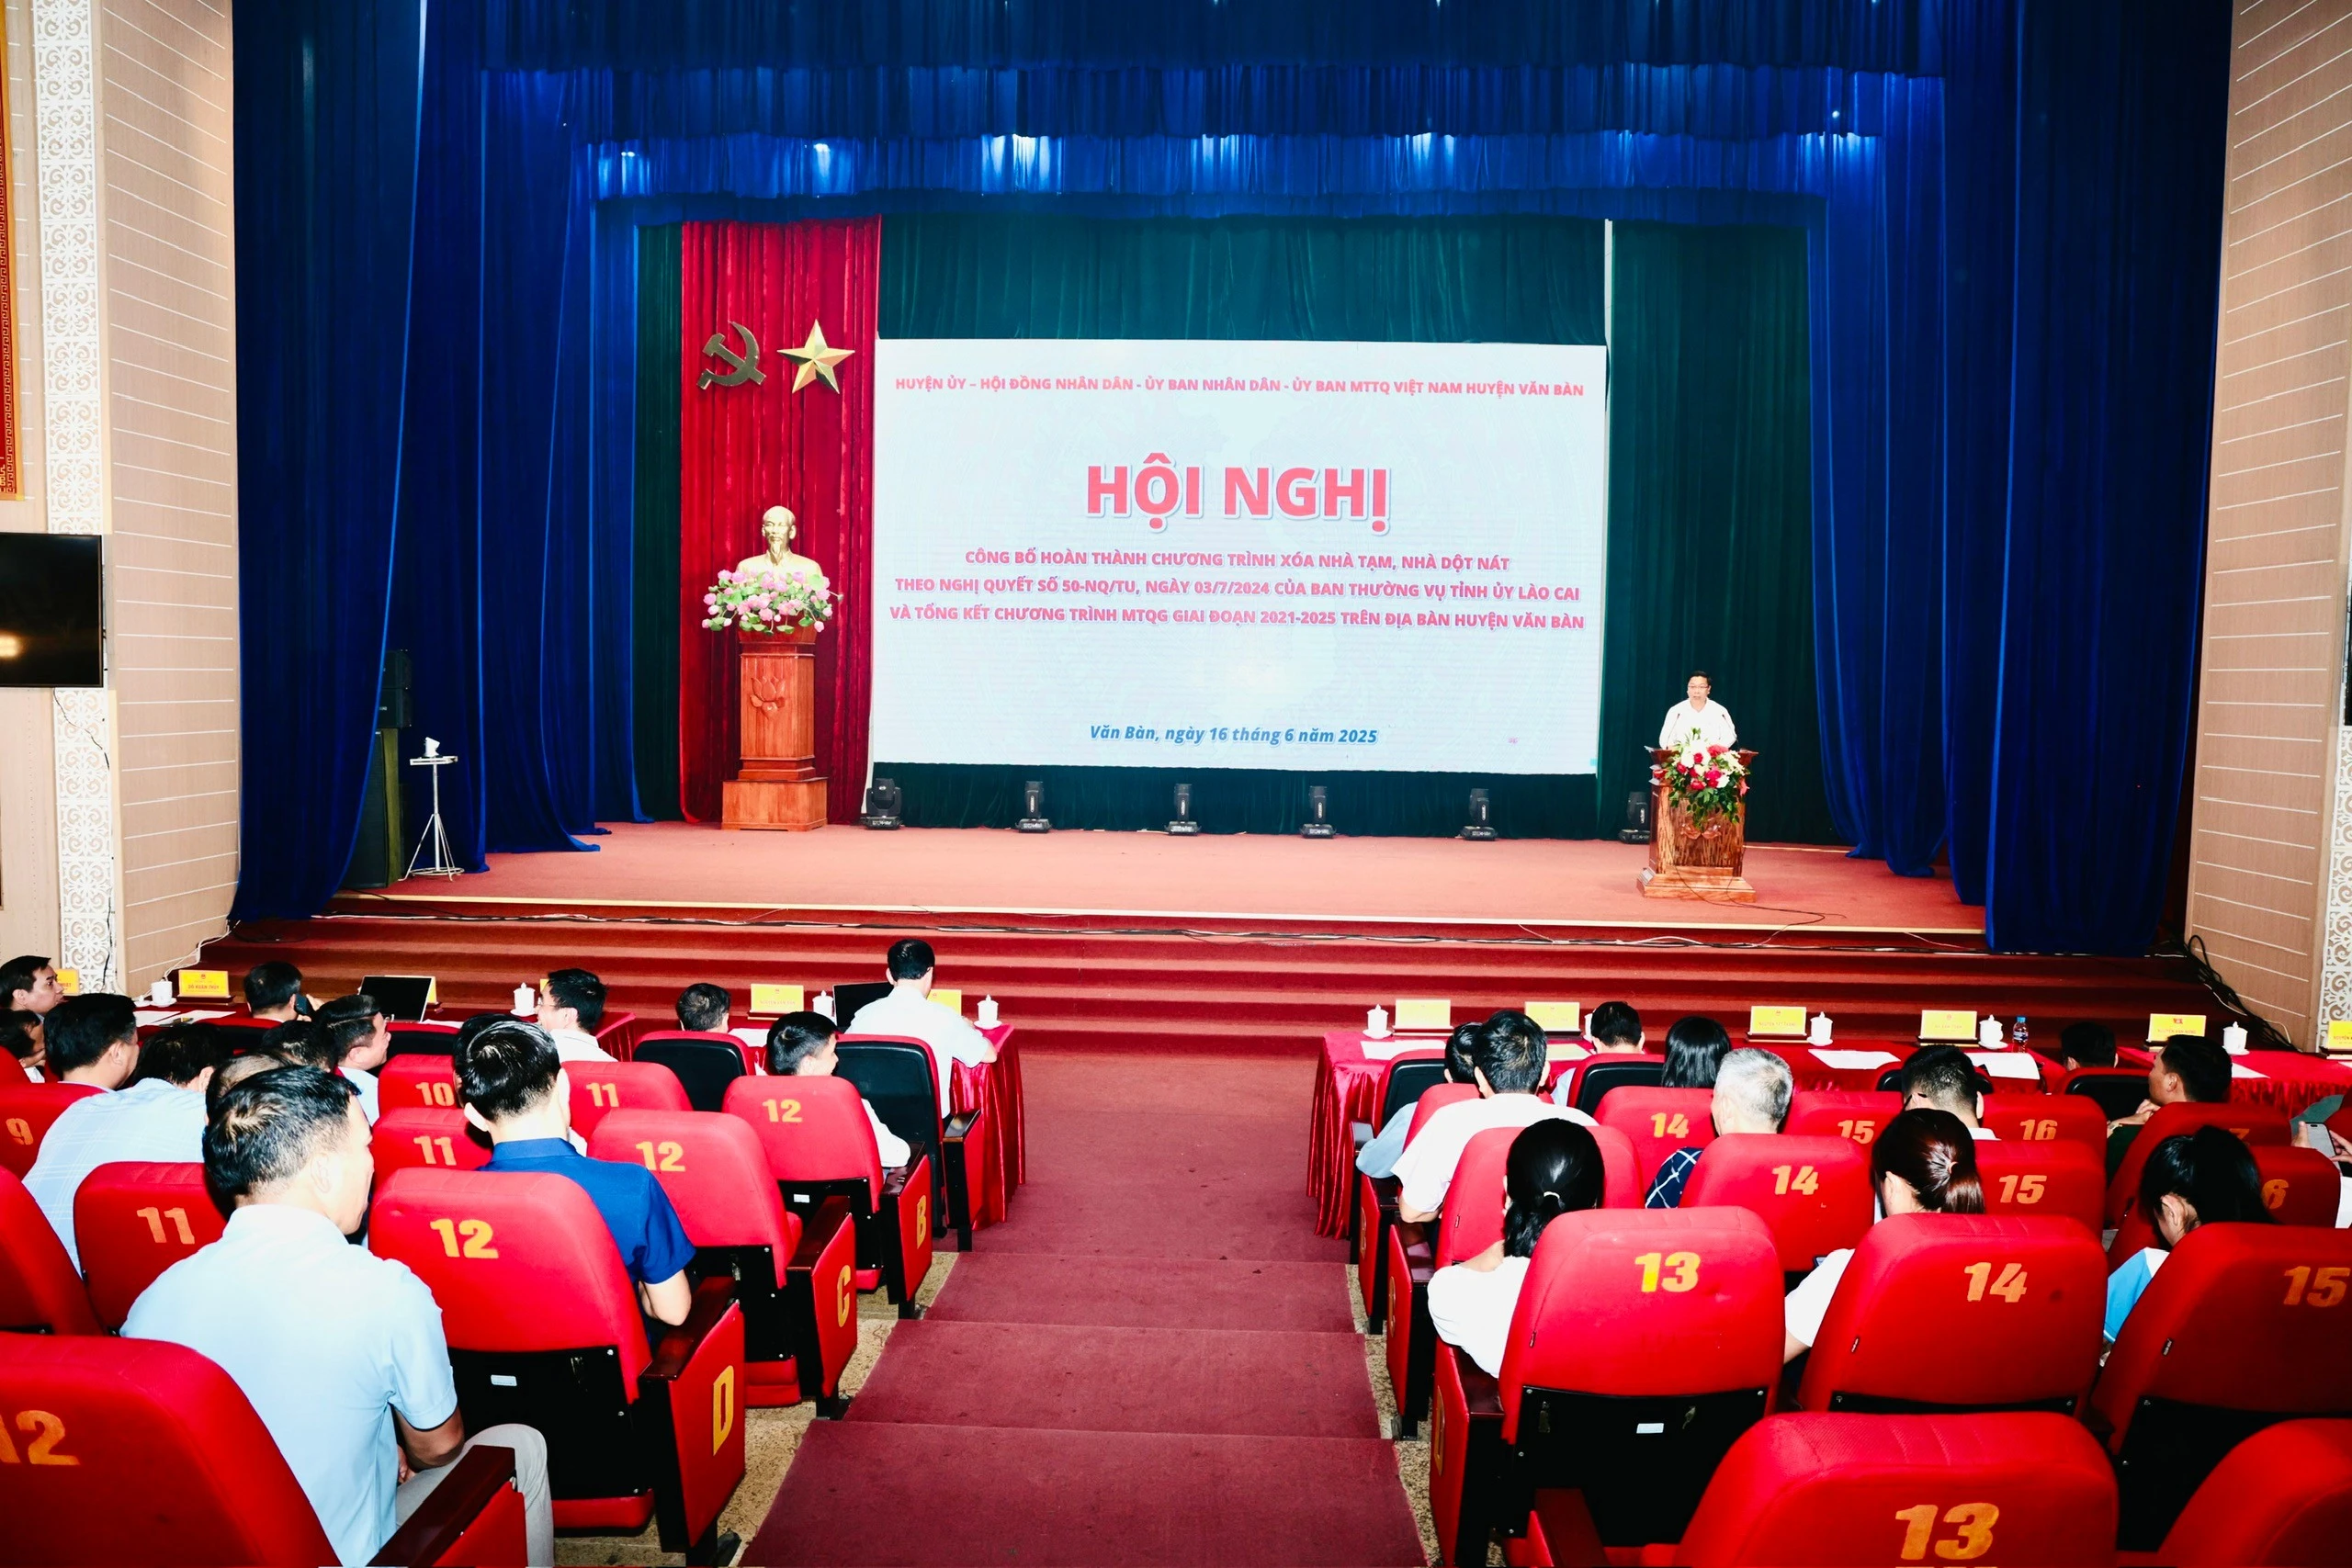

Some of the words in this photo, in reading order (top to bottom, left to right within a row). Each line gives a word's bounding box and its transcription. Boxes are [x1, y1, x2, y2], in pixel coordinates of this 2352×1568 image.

[895, 375, 944, 392] HUYỆN
[946, 374, 967, 390] ỦY
[979, 375, 1007, 392] HỘI
[1008, 375, 1053, 390] ĐỒNG
[1055, 376, 1100, 390] NHÂN
[1102, 376, 1134, 390] DÂN
[1145, 375, 1165, 390] ỦY
[1168, 378, 1199, 390] BAN
[1203, 377, 1247, 391] NHÂN
[1249, 378, 1282, 391] DÂN
[1292, 378, 1312, 392] ỦY
[1315, 379, 1347, 392] BAN
[1349, 380, 1391, 395] MTTQ
[1394, 378, 1424, 396] VIỆT
[1427, 381, 1464, 394] NAM
[1465, 380, 1516, 398] HUYỆN
[1518, 381, 1551, 396] VĂN
[1553, 382, 1585, 397] BÀN
[1087, 452, 1201, 530] HỘI
[1224, 467, 1387, 533] NGHỊ
[965, 547, 1011, 565] CÔNG
[1014, 547, 1037, 565] BỐ
[1040, 549, 1088, 565] HOÀN
[1092, 549, 1148, 565] THÀNH
[1150, 552, 1224, 567] CHƯƠNG
[1227, 552, 1277, 567] TRÌNH
[1281, 552, 1315, 568] XÓA
[1318, 553, 1355, 568] NHÀ
[1359, 554, 1396, 571] TẠM,
[1401, 554, 1438, 570] NHÀ
[1441, 554, 1474, 572] DỘT
[1476, 555, 1510, 570] NÁT
[896, 578, 936, 592] THEO
[939, 578, 980, 594] NGHỊ
[983, 576, 1034, 594] QUYẾT
[1037, 576, 1059, 592] SỐ
[1061, 579, 1141, 597] 50-NQ/TU,
[1145, 578, 1191, 594] NGÀY
[1193, 581, 1270, 595] 03/7/2024
[1274, 579, 1306, 596] CỦA
[1310, 581, 1345, 596] BAN
[1349, 581, 1420, 598] THƯỜNG
[1423, 584, 1447, 601] VỤ
[1450, 581, 1489, 598] TỈNH
[1492, 581, 1514, 600] ỦY
[1518, 583, 1551, 601] LÀO
[1554, 586, 1581, 601] CAI
[890, 604, 911, 619] VÀ
[914, 603, 959, 620] TỔNG
[963, 604, 990, 621] KẾT
[994, 607, 1067, 621] CHƯƠNG
[1069, 606, 1118, 622] TRÌNH
[1122, 608, 1169, 624] MTQG
[1172, 609, 1205, 623] GIAI
[1209, 607, 1256, 626] ĐOẠN
[1261, 611, 1337, 625] 2021-2025
[1340, 609, 1381, 626] TRÊN
[1385, 612, 1414, 628] ĐỊA
[1416, 611, 1451, 627] BÀN
[1454, 611, 1510, 629] HUYỆN
[1512, 612, 1547, 628] VĂN
[1550, 613, 1585, 629] BÀN
[1090, 725, 1120, 739] Văn
[1125, 726, 1159, 741] Bàn,
[1165, 727, 1204, 744] ngày
[1209, 728, 1227, 740] 16
[1232, 728, 1281, 745] tháng
[1284, 728, 1295, 741] 6
[1298, 728, 1333, 742] năm
[1338, 729, 1377, 743] 2025
[415, 1082, 455, 1106] 10
[588, 1082, 619, 1107] 11
[763, 1099, 802, 1122] 12
[1651, 1112, 1689, 1138] 14
[6, 1118, 34, 1145] 9
[1838, 1120, 1875, 1145] 15
[2020, 1119, 2058, 1140] 16
[413, 1135, 457, 1165] 11
[635, 1142, 685, 1171] 12
[1772, 1165, 1819, 1195] 14
[1998, 1175, 2048, 1204] 15
[2261, 1179, 2290, 1210] 6
[137, 1207, 196, 1245] 11
[916, 1195, 927, 1249] B
[430, 1219, 499, 1258] 12
[1635, 1251, 1700, 1292] 13
[1963, 1261, 2028, 1303] 14
[2284, 1265, 2352, 1307] 15
[713, 1365, 734, 1456] D
[1894, 1502, 2000, 1561] 13
